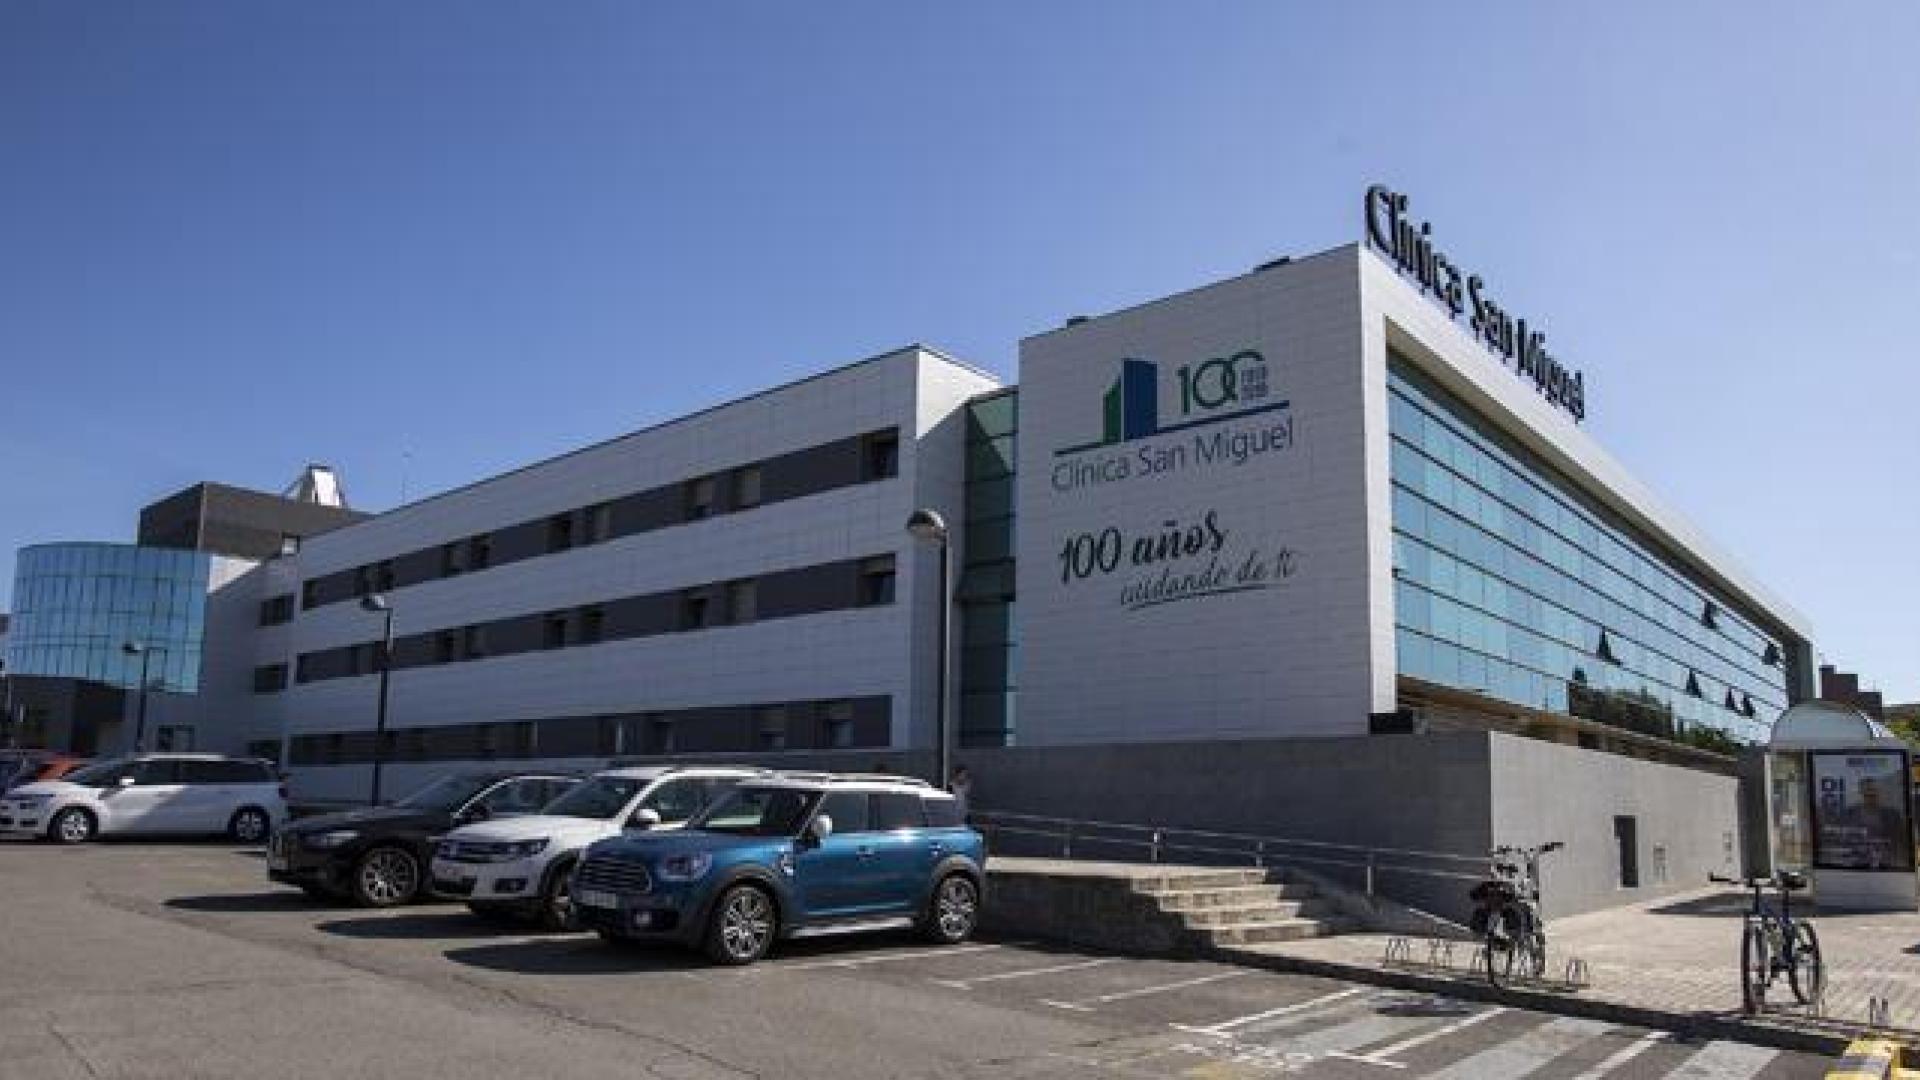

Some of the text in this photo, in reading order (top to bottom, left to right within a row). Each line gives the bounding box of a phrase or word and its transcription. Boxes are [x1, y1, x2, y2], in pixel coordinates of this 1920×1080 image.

[1467, 274, 1515, 358] San
[1516, 319, 1584, 420] Miguel
[1138, 445, 1185, 476] San
[1195, 415, 1294, 466] Miguel
[1060, 508, 1229, 584] 100 años
[1121, 556, 1228, 606] cuidando
[1235, 550, 1267, 584] de
